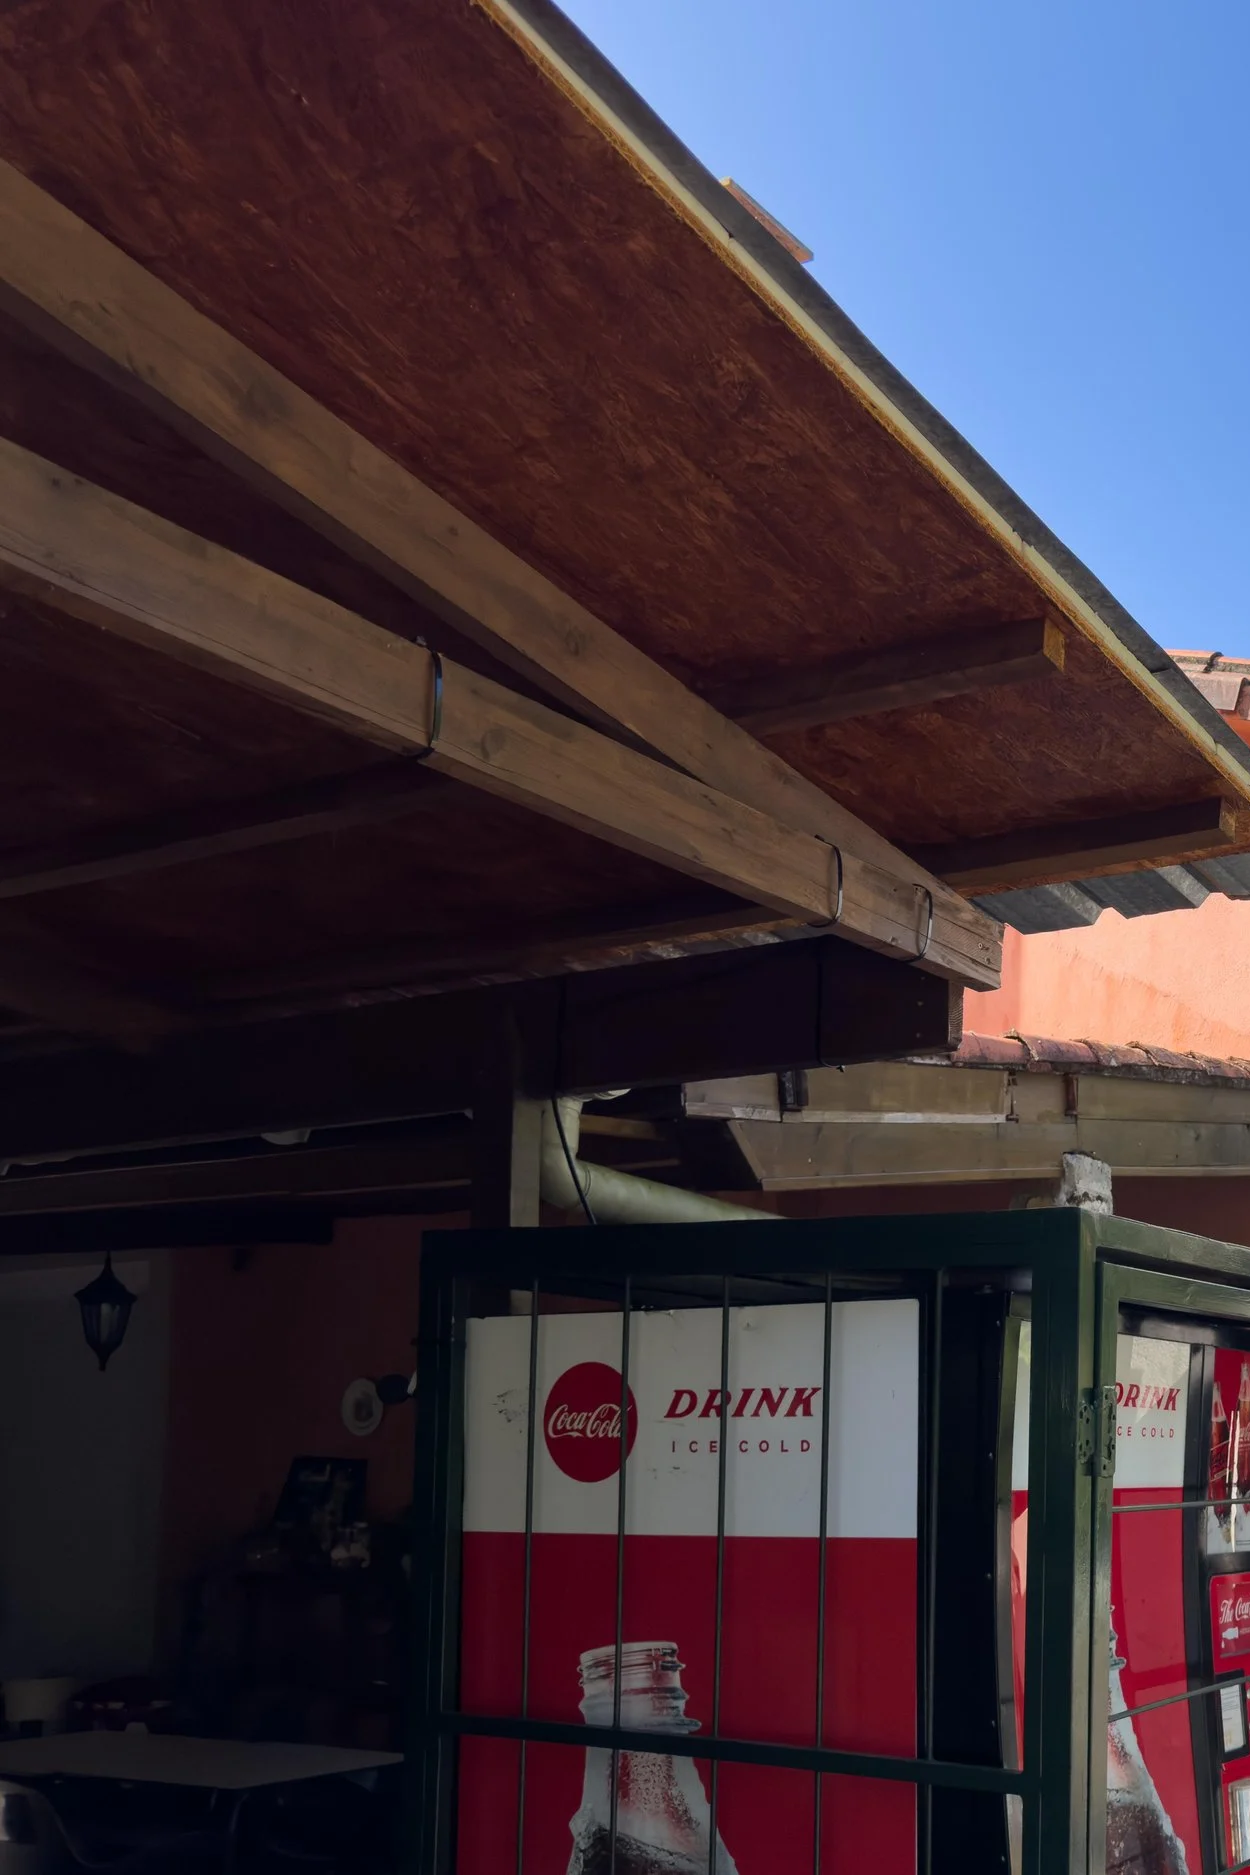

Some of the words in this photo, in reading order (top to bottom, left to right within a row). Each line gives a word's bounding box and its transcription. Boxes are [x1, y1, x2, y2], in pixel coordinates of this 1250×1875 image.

[664, 1386, 822, 1419] DRINK
[547, 1403, 633, 1439] Coca-Cola
[1141, 1427, 1175, 1439] COLD
[672, 1440, 719, 1453] ICE
[738, 1439, 811, 1453] COLD
[1219, 1597, 1234, 1625] The
